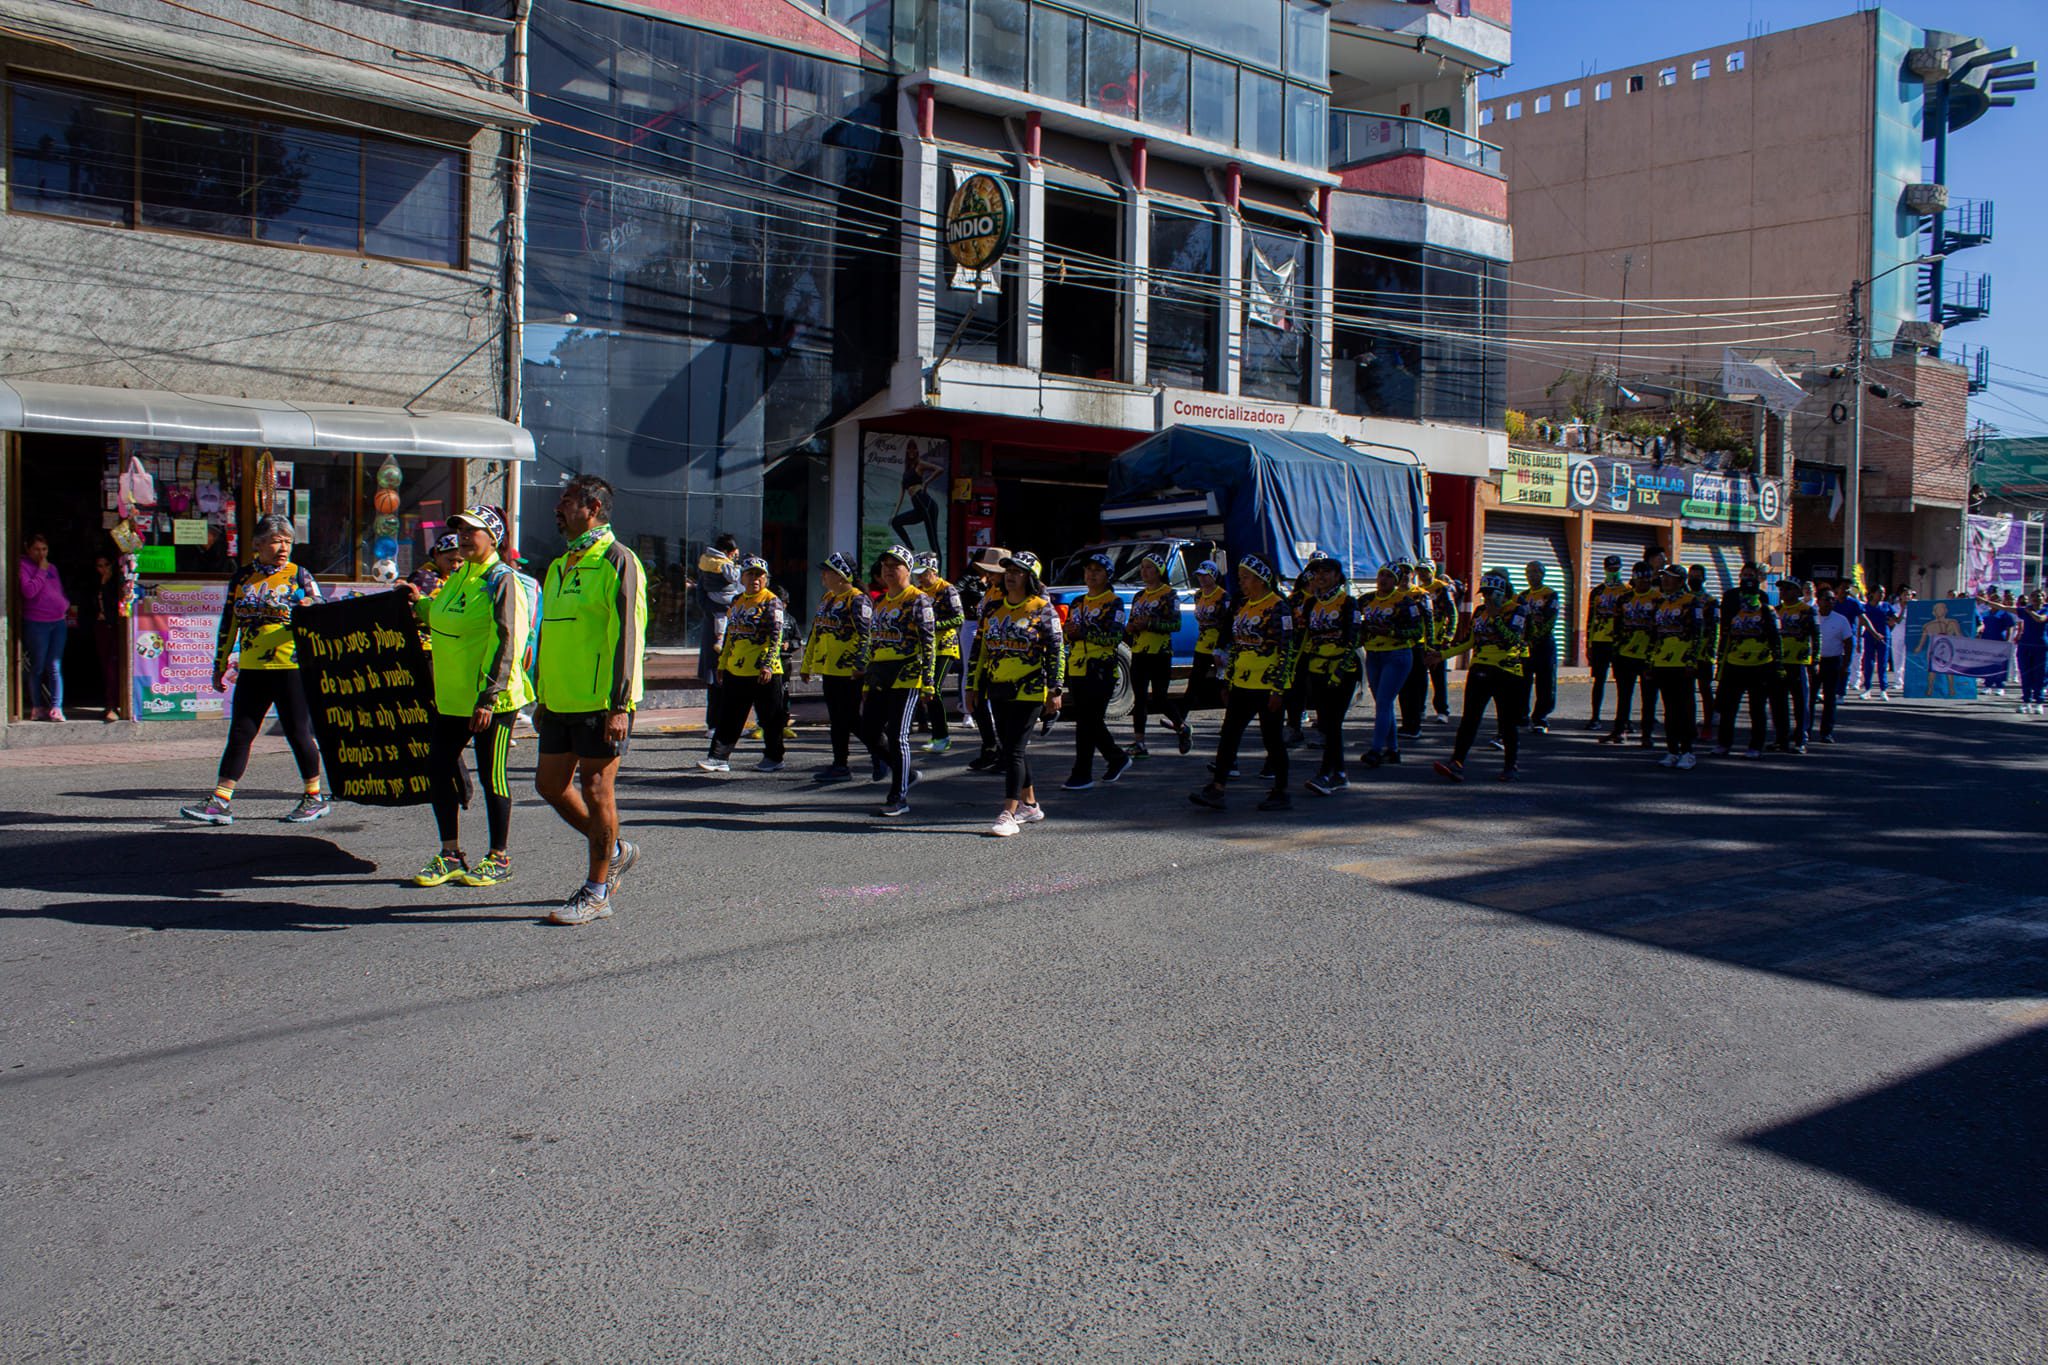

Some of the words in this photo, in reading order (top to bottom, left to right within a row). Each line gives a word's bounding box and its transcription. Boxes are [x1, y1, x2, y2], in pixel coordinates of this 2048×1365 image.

[948, 215, 994, 241] INDIO
[1174, 400, 1285, 424] Comercializadora
[1508, 451, 1531, 466] ESTOS
[1532, 455, 1562, 469] LOCALES
[1517, 468, 1530, 484] NO
[1636, 474, 1685, 493] CELULAR
[1529, 490, 1551, 504] RENTA
[1637, 490, 1661, 505] TEX
[1695, 488, 1704, 500] DE
[162, 592, 220, 600] Cosméticos
[152, 604, 182, 613] Bolsas
[186, 604, 199, 613] de
[202, 604, 223, 613] Man
[169, 618, 213, 627] Mochilas
[172, 630, 210, 639] Bocinas
[167, 642, 215, 650] Memorias
[172, 655, 210, 663] Maletas
[162, 668, 214, 678] Cargadore
[152, 684, 180, 694] Cajas
[182, 684, 194, 693] de
